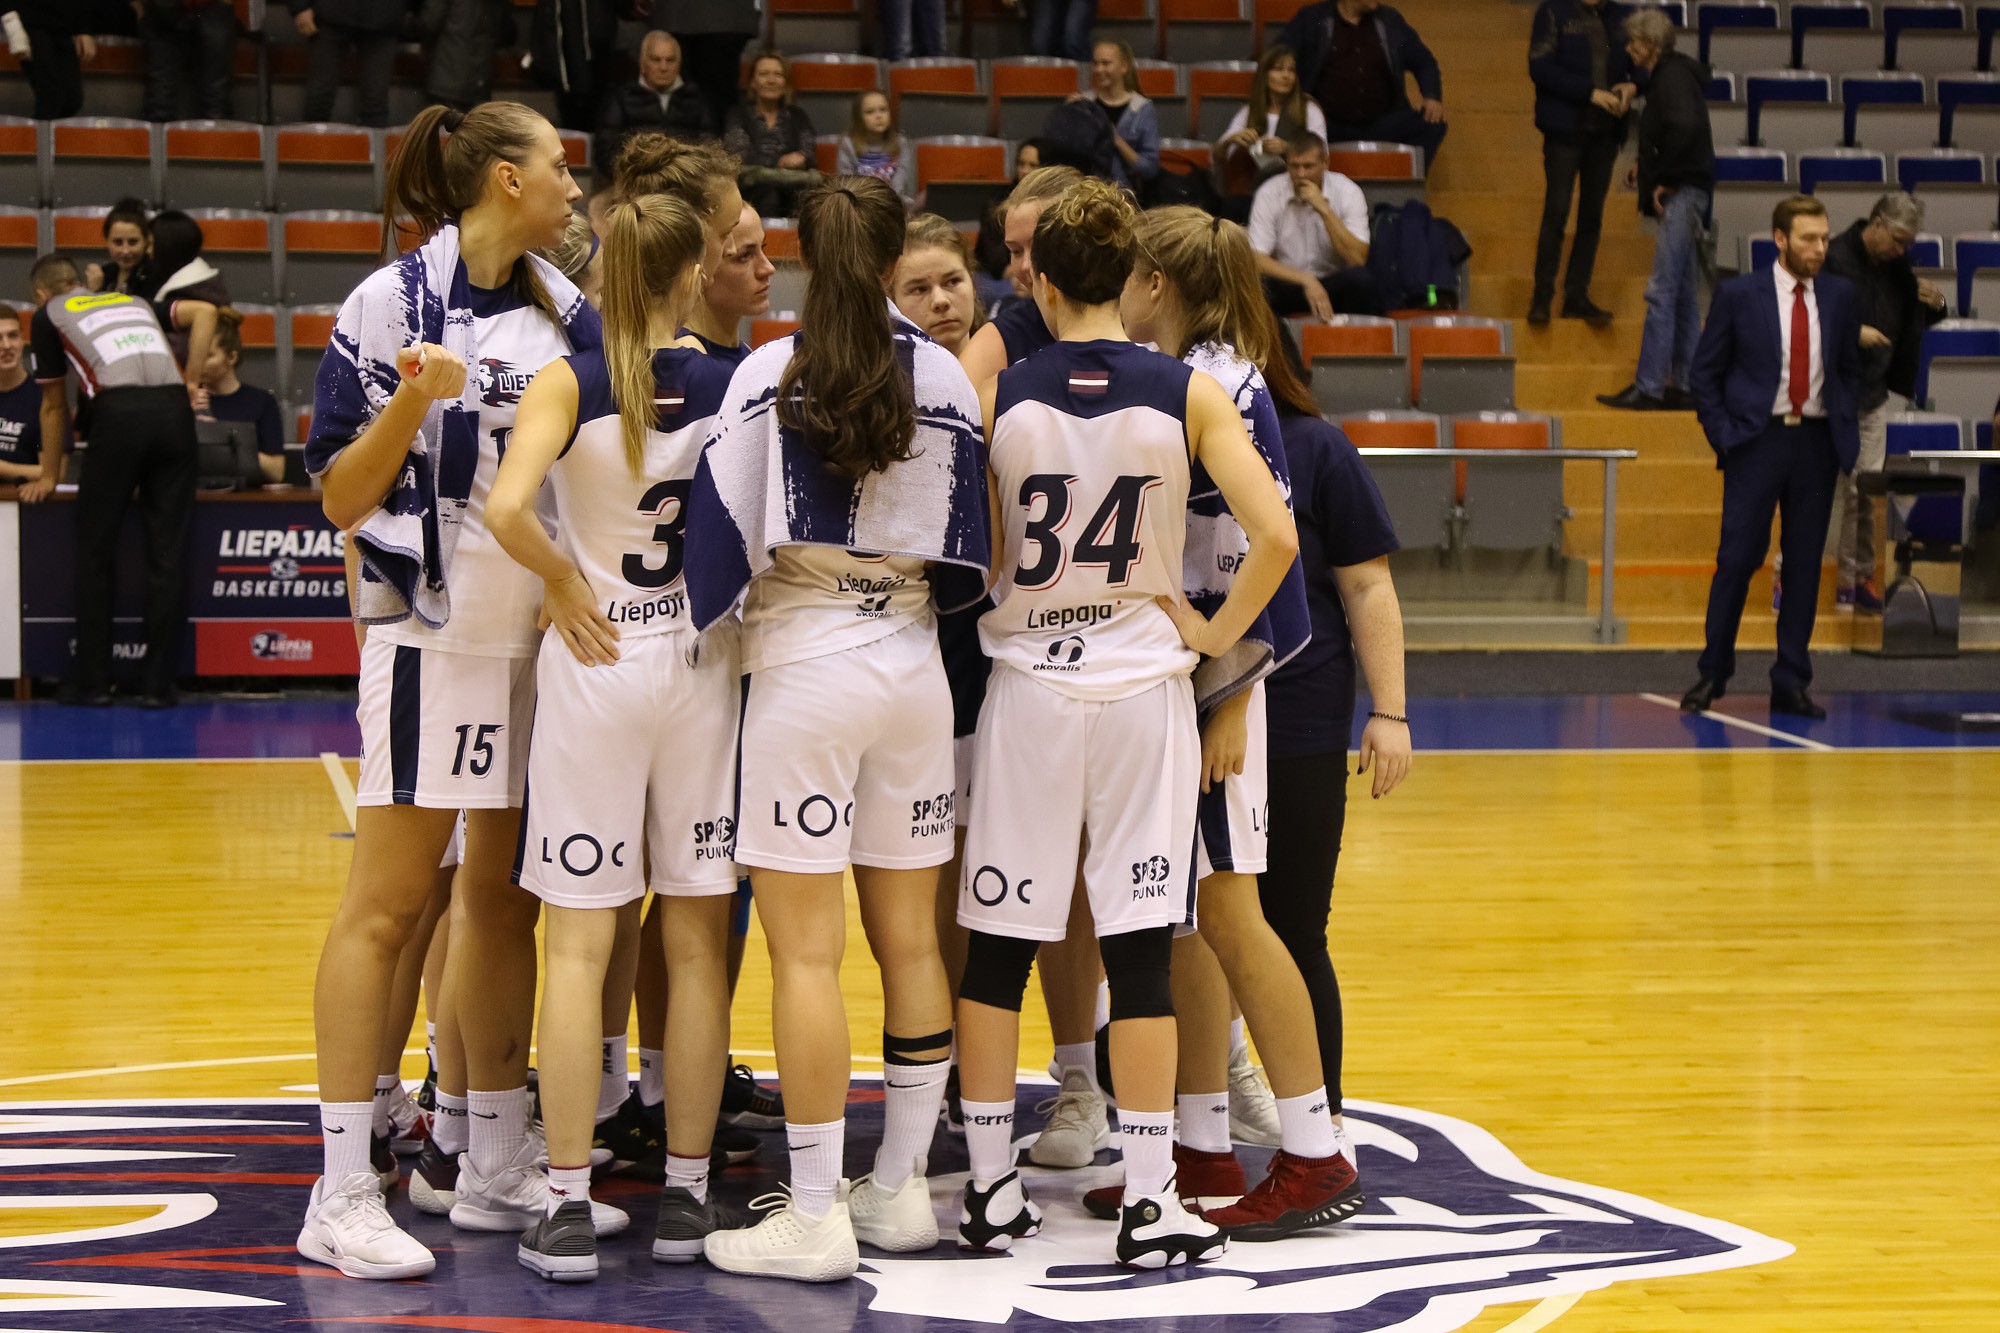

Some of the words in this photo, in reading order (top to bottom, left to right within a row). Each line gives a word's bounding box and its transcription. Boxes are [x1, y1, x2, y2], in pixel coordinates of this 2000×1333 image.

[621, 478, 694, 593] 3
[1014, 473, 1167, 591] 34
[212, 580, 347, 598] BASKETBOLS
[1032, 662, 1081, 672] ekovalis
[450, 724, 506, 780] 15
[542, 833, 625, 877] LOC
[696, 844, 732, 860] PUNK
[1132, 884, 1169, 902] PUNK
[974, 1112, 1015, 1126] erre
